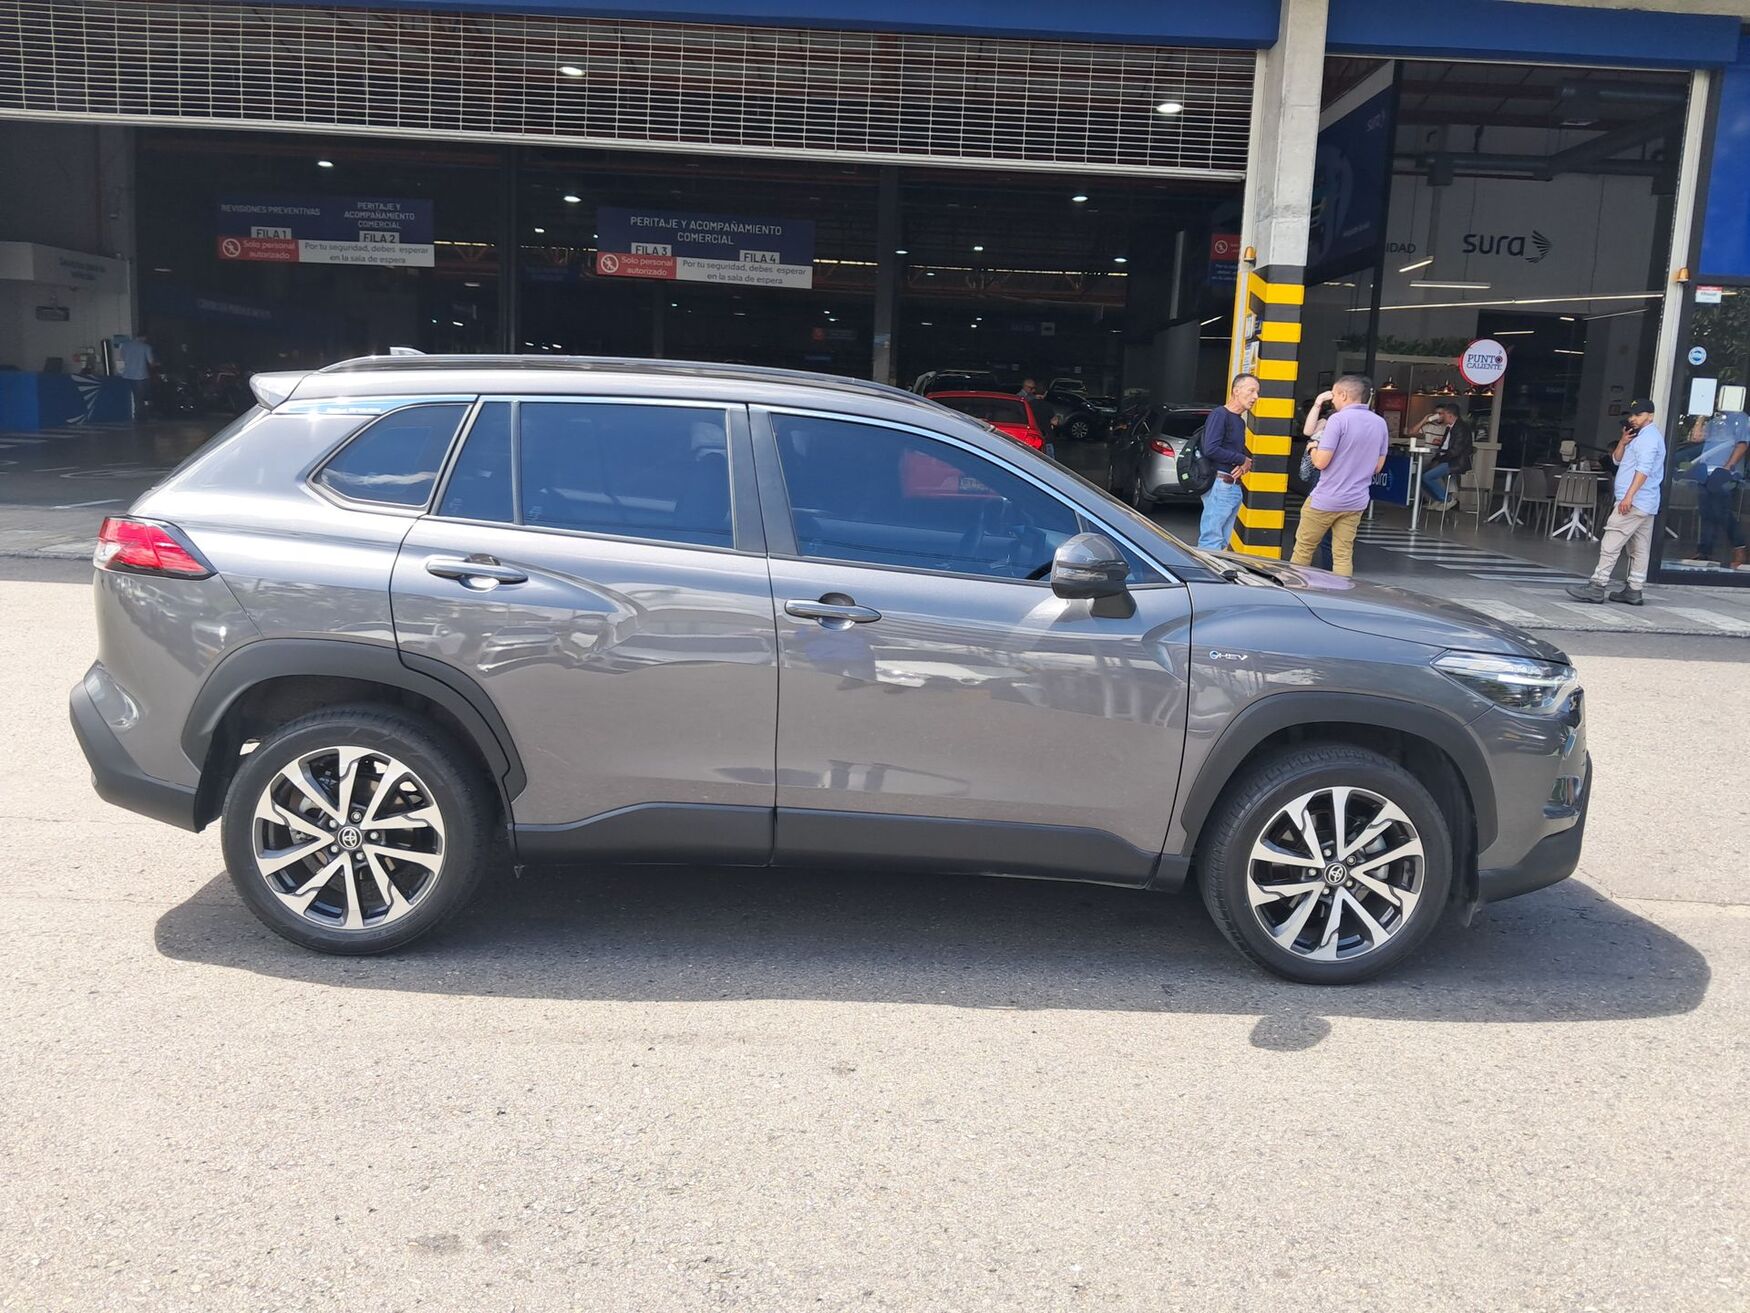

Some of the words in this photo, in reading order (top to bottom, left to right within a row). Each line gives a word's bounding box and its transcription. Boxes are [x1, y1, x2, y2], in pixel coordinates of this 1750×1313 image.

[221, 204, 267, 214] REVISIONES
[269, 206, 320, 216] PREVENTIVAS
[357, 202, 396, 210] PERITAJE
[344, 210, 415, 220] ACOMPAÑAMIENTO
[358, 220, 401, 229] COMERCIAL
[630, 216, 679, 228] PERITAJE
[689, 220, 782, 236] ACOMPAÑAMIENTO
[256, 228, 281, 239] FILA
[363, 233, 386, 243] FILA
[388, 235, 396, 244] 2
[677, 232, 735, 245] COMERCIAL
[243, 240, 261, 248] Solo
[262, 242, 296, 250] personal
[305, 242, 318, 250] Por
[399, 247, 428, 255] esperar
[635, 245, 659, 256] FILA
[661, 246, 668, 256] 3
[1463, 233, 1525, 257] sura
[341, 254, 349, 262] la
[367, 256, 378, 264] de
[621, 256, 639, 265] Solo
[640, 259, 673, 268] personal
[744, 252, 767, 264] FILA
[769, 254, 776, 264] 4
[626, 267, 668, 277] autorizado
[682, 260, 696, 268] Por
[697, 261, 705, 269] tu
[706, 262, 748, 274] seguridad,
[749, 264, 772, 273] debes
[776, 267, 807, 277] esperar
[719, 273, 726, 281] la
[727, 274, 744, 282] sala
[745, 275, 755, 283] de
[757, 277, 783, 285] espera
[1467, 354, 1503, 365] PUNTO
[1466, 362, 1503, 371] CALIENTE
